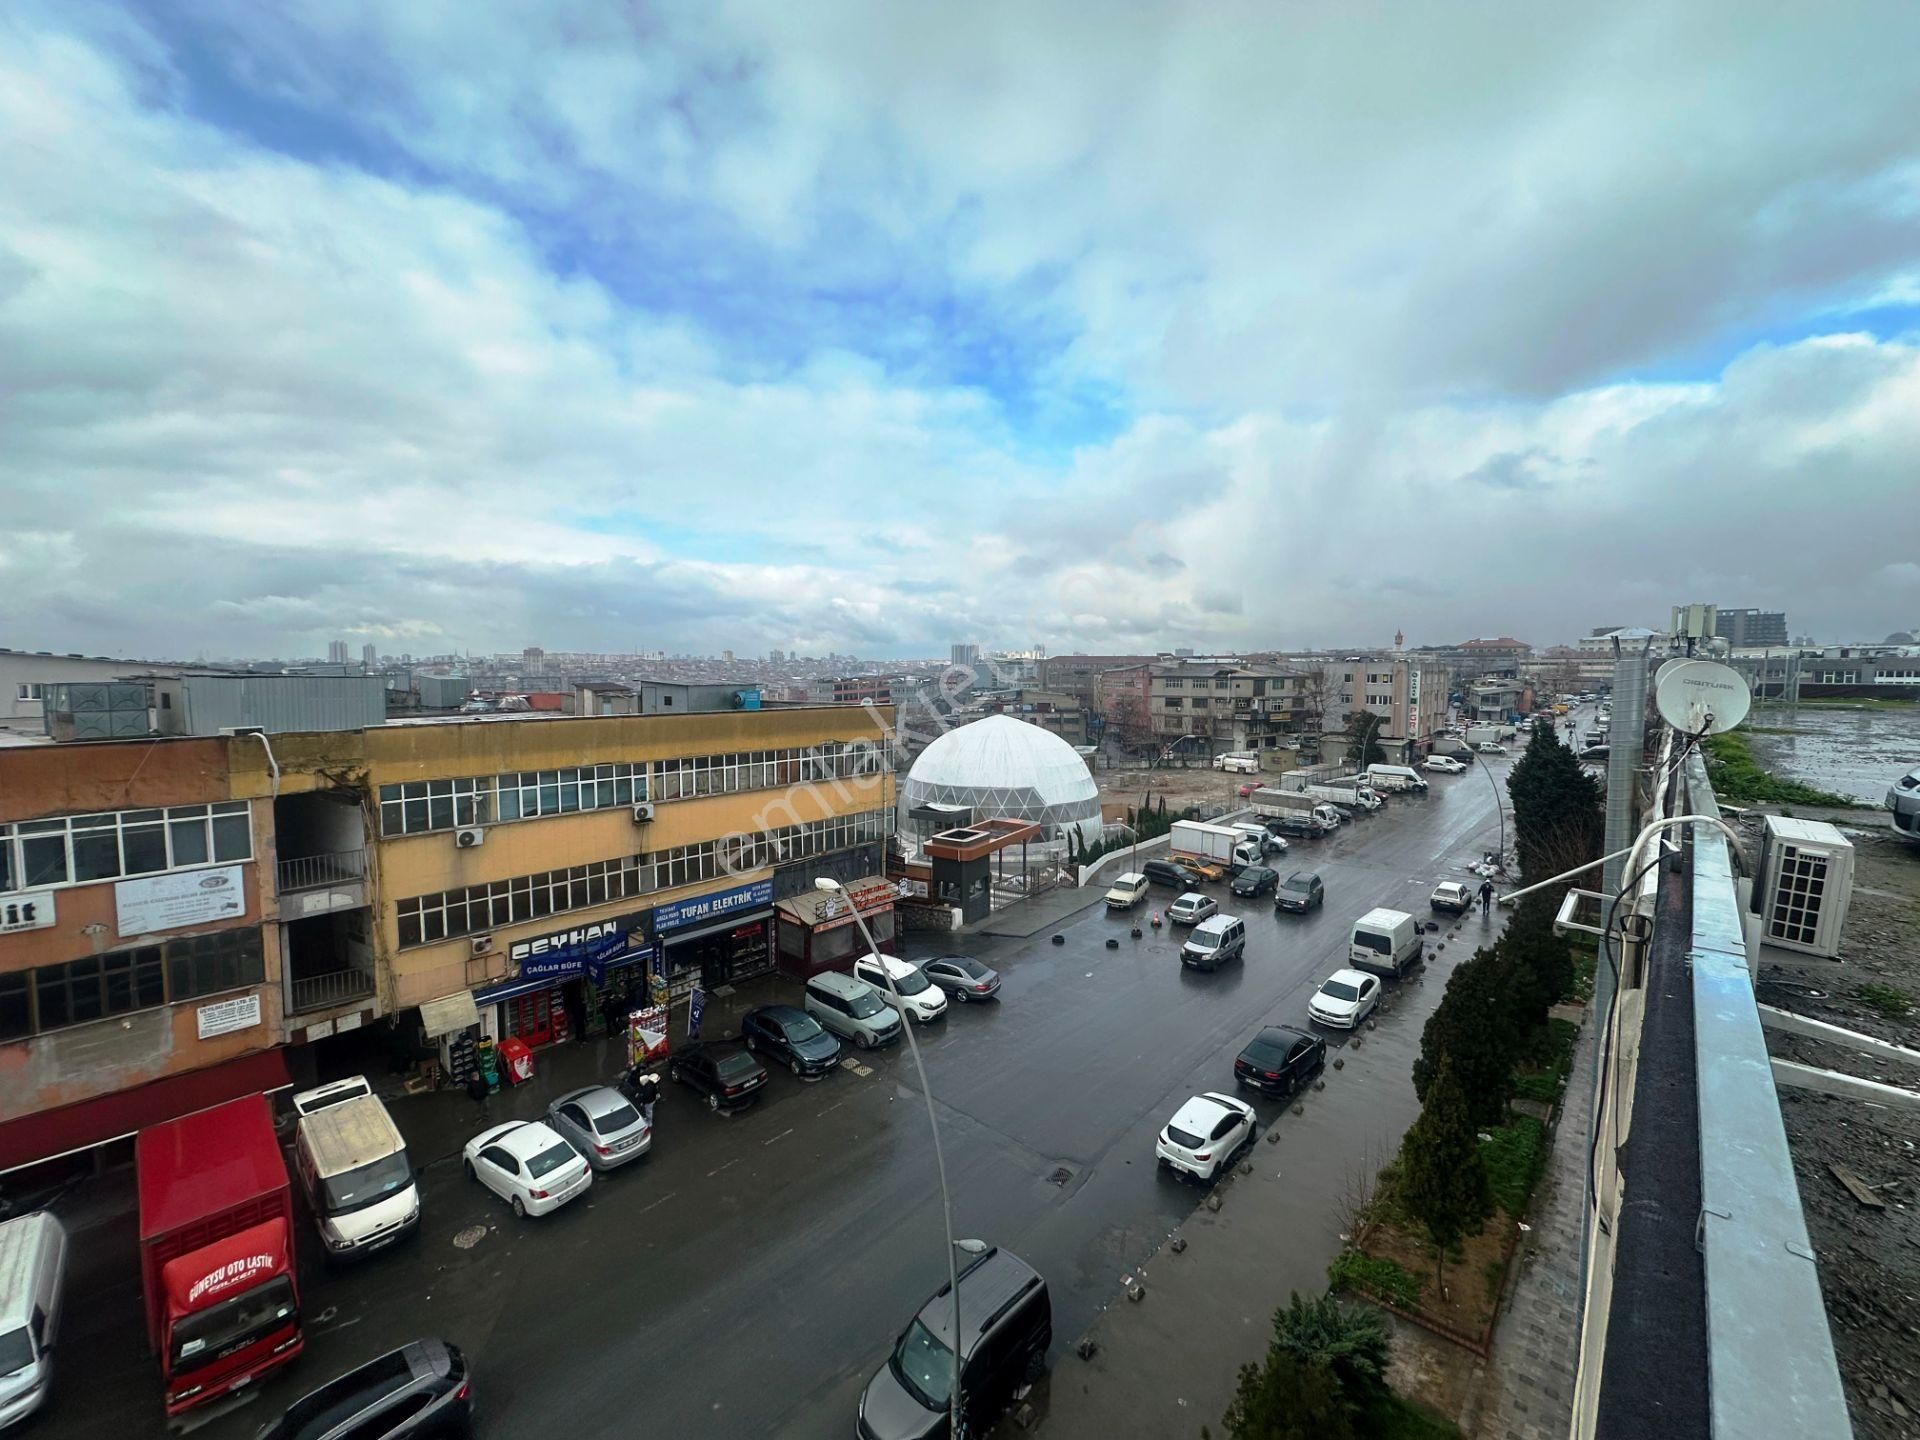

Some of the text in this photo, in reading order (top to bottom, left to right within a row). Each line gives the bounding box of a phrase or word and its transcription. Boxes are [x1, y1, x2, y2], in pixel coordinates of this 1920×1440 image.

[0, 902, 36, 924] it
[680, 902, 709, 919] TUFAN
[712, 890, 752, 911] ELEKTRİK
[512, 921, 617, 960] CEYHAN
[526, 961, 582, 975] ÇAĞLAR BÜFE
[189, 1252, 273, 1303] GÜNEYSU OTO LASTİK
